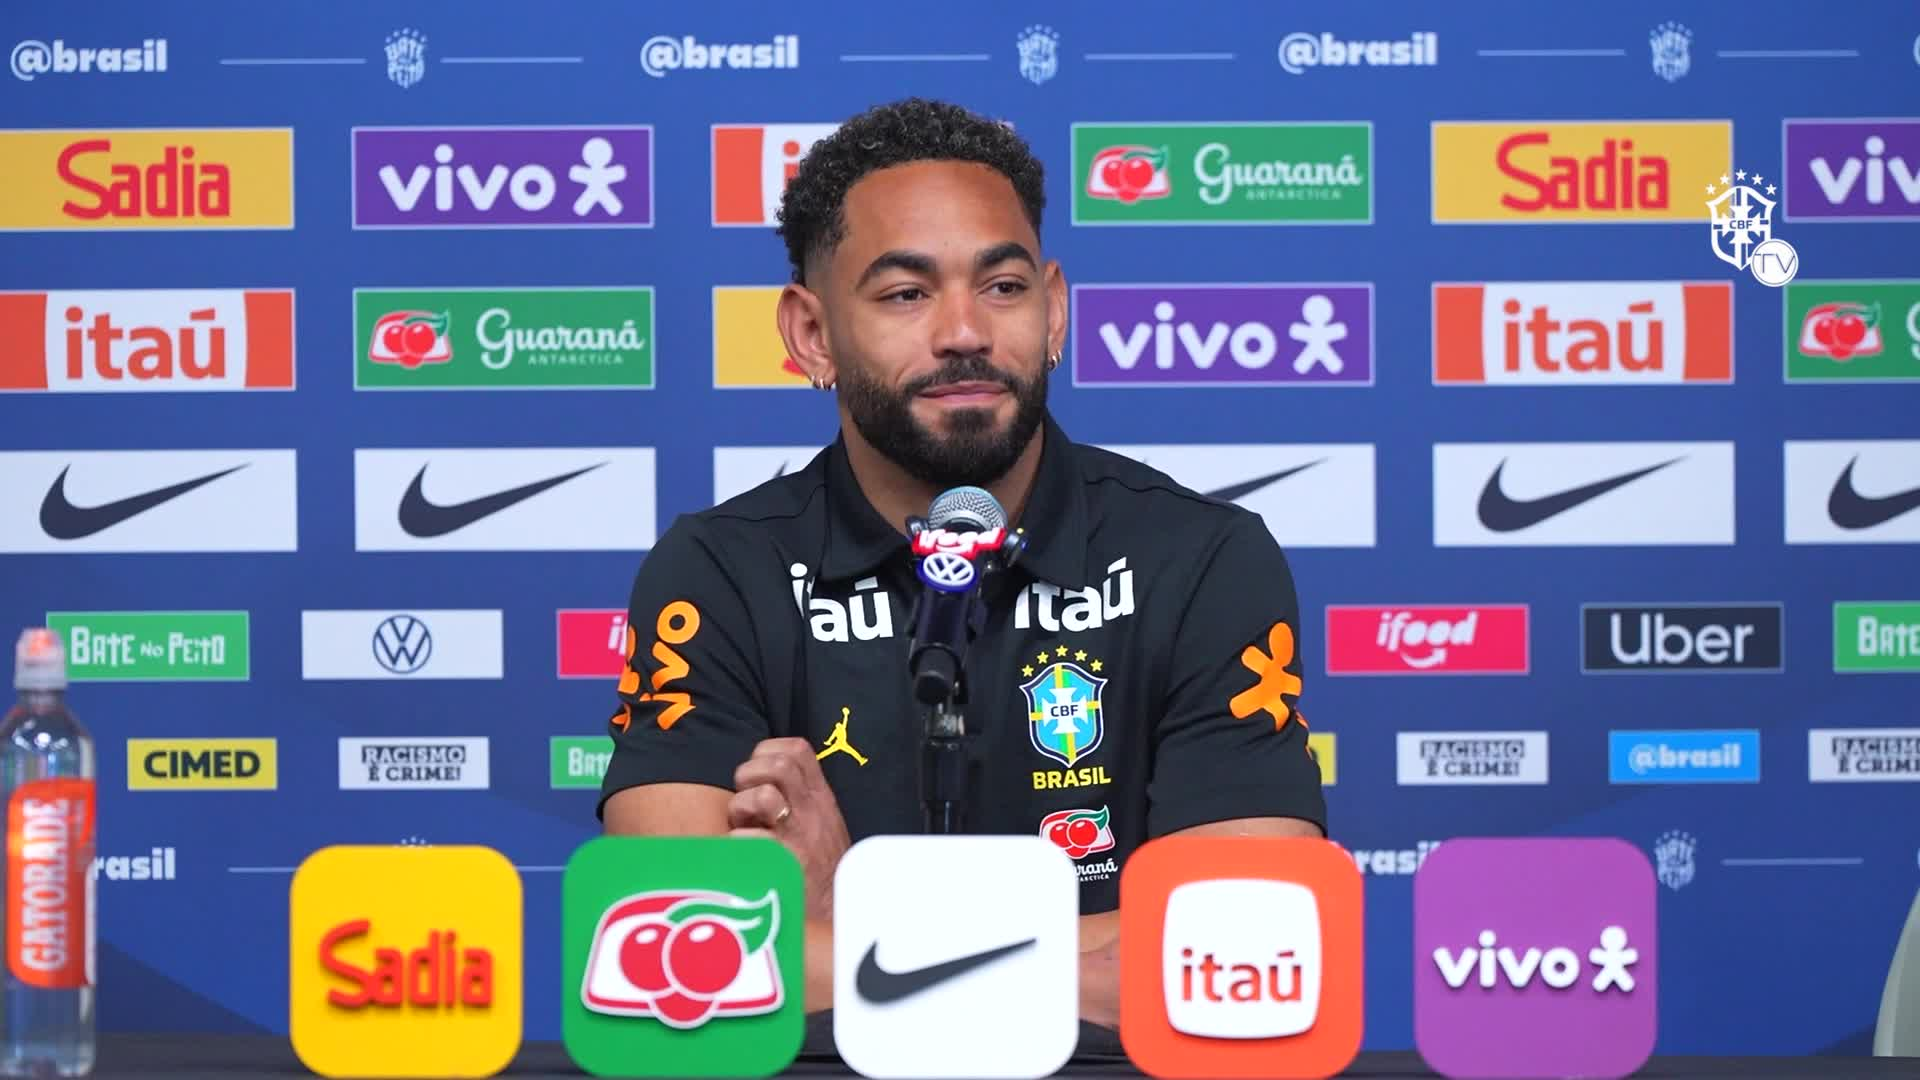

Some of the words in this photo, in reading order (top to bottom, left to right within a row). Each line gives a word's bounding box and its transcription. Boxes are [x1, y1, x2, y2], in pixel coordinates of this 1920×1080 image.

[10, 38, 168, 81] @brasil
[640, 34, 799, 78] @brasil
[1278, 31, 1438, 75] @brasil
[57, 139, 231, 220] Sadia
[379, 144, 556, 211] vivo
[1194, 142, 1363, 205] Guaraná
[1496, 132, 1670, 212] Sadia
[1809, 136, 1920, 204] viv
[65, 306, 226, 380] itaú
[476, 307, 645, 370] Guaraná
[1100, 302, 1277, 369] vivo
[1504, 299, 1664, 372] itaú
[527, 353, 623, 366] ANTARCTICA
[790, 562, 894, 643] iaú
[1377, 611, 1478, 652] ifood
[1610, 613, 1754, 663] Uber
[1051, 704, 1079, 717] CBF
[143, 750, 261, 779] CIMED
[361, 745, 466, 764] RACISMO
[568, 747, 613, 778] BAT
[1628, 743, 1741, 775] @brasil
[1832, 737, 1920, 756] RACISM
[385, 765, 461, 782] CRIME!
[1032, 766, 1112, 790] BRASIL
[20, 797, 70, 972] GATORADE
[92, 847, 176, 880] rasil
[1075, 857, 1119, 876] raná
[318, 918, 495, 1008] Sadia
[1181, 947, 1302, 1003] itaú
[1433, 931, 1580, 989] vivo
